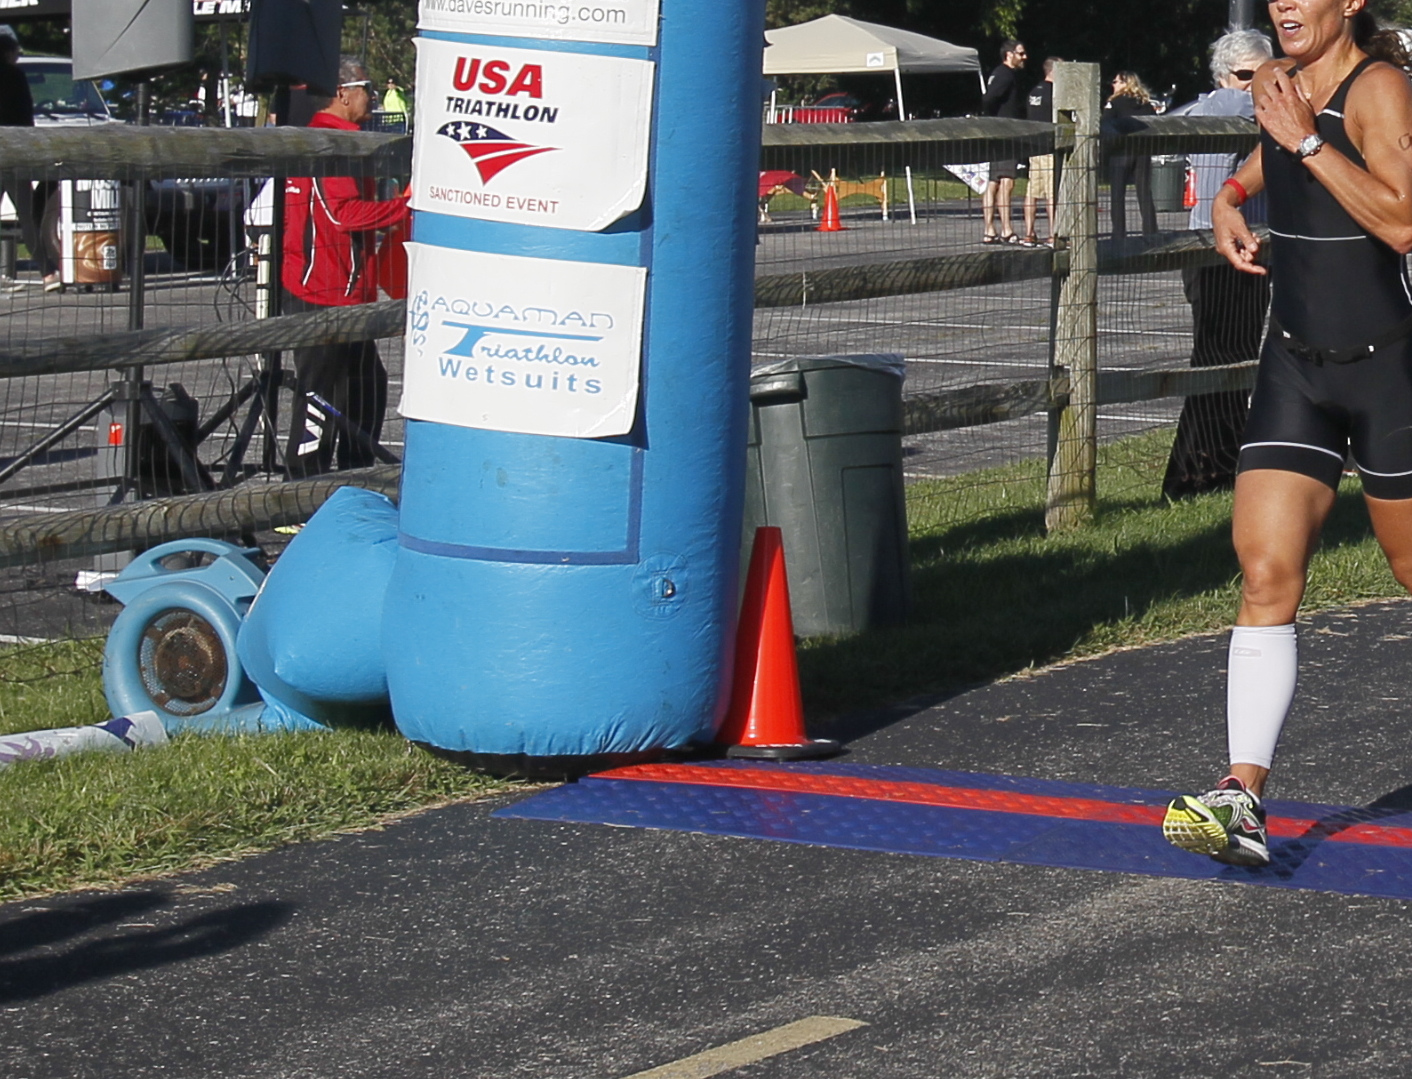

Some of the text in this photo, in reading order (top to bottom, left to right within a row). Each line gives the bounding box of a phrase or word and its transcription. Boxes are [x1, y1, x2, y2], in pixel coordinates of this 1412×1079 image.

[452, 56, 543, 99] USA
[445, 96, 559, 123] TRIATHLON
[429, 185, 560, 214] SANCTIONED EVENT
[431, 295, 614, 330] AQUAMAN
[441, 320, 605, 368] Triathlon
[438, 357, 602, 395] Wetsuits
